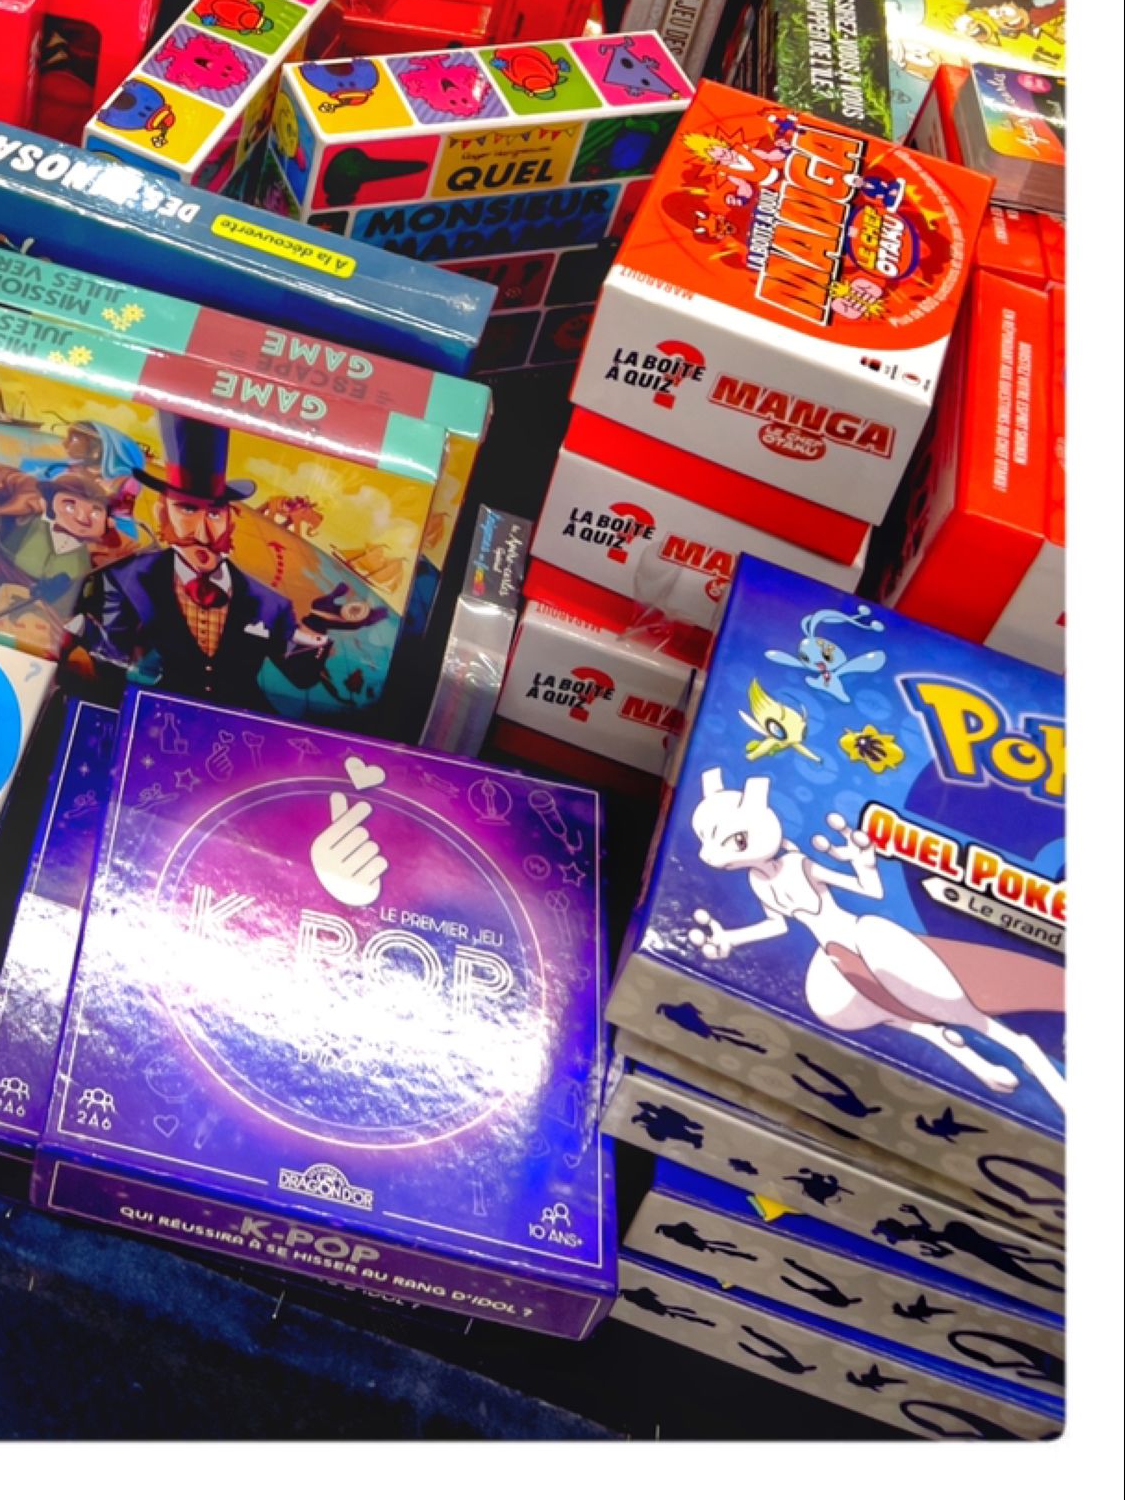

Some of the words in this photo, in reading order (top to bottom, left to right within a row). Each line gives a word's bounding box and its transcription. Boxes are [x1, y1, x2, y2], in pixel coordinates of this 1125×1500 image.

[447, 159, 553, 193] QUEL
[364, 189, 610, 238] MONSIEUR
[860, 205, 881, 245] CHEF
[858, 248, 876, 270] LE
[876, 213, 905, 278] OTAKU
[49, 263, 126, 305] JULES
[605, 362, 620, 381] À
[623, 368, 674, 393] QUIZ
[614, 348, 637, 366] LA
[642, 357, 704, 382] BOÎTE
[711, 375, 895, 455] MANGA
[569, 507, 592, 526] LA
[596, 515, 656, 539] BOÎTE
[533, 672, 555, 688] LA
[558, 679, 615, 701] BOÎTE
[867, 809, 963, 876] QUEL
[381, 906, 398, 923] LE
[401, 911, 469, 940] PREMIER
[473, 931, 504, 948] JEU
[968, 898, 992, 917] Le
[1001, 913, 1062, 946] grand
[239, 1215, 381, 1265] K-POP
[529, 1223, 545, 1239] 10
[120, 1206, 154, 1223] QUI
[158, 1212, 246, 1247] RÉUSSIRA
[248, 1232, 262, 1248] À
[267, 1241, 289, 1256] SE
[293, 1250, 357, 1275] HISSER
[361, 1267, 387, 1283] AU
[392, 1276, 446, 1297] RANG
[451, 1289, 518, 1317] D'IDOL
[523, 1308, 534, 1321] ?
